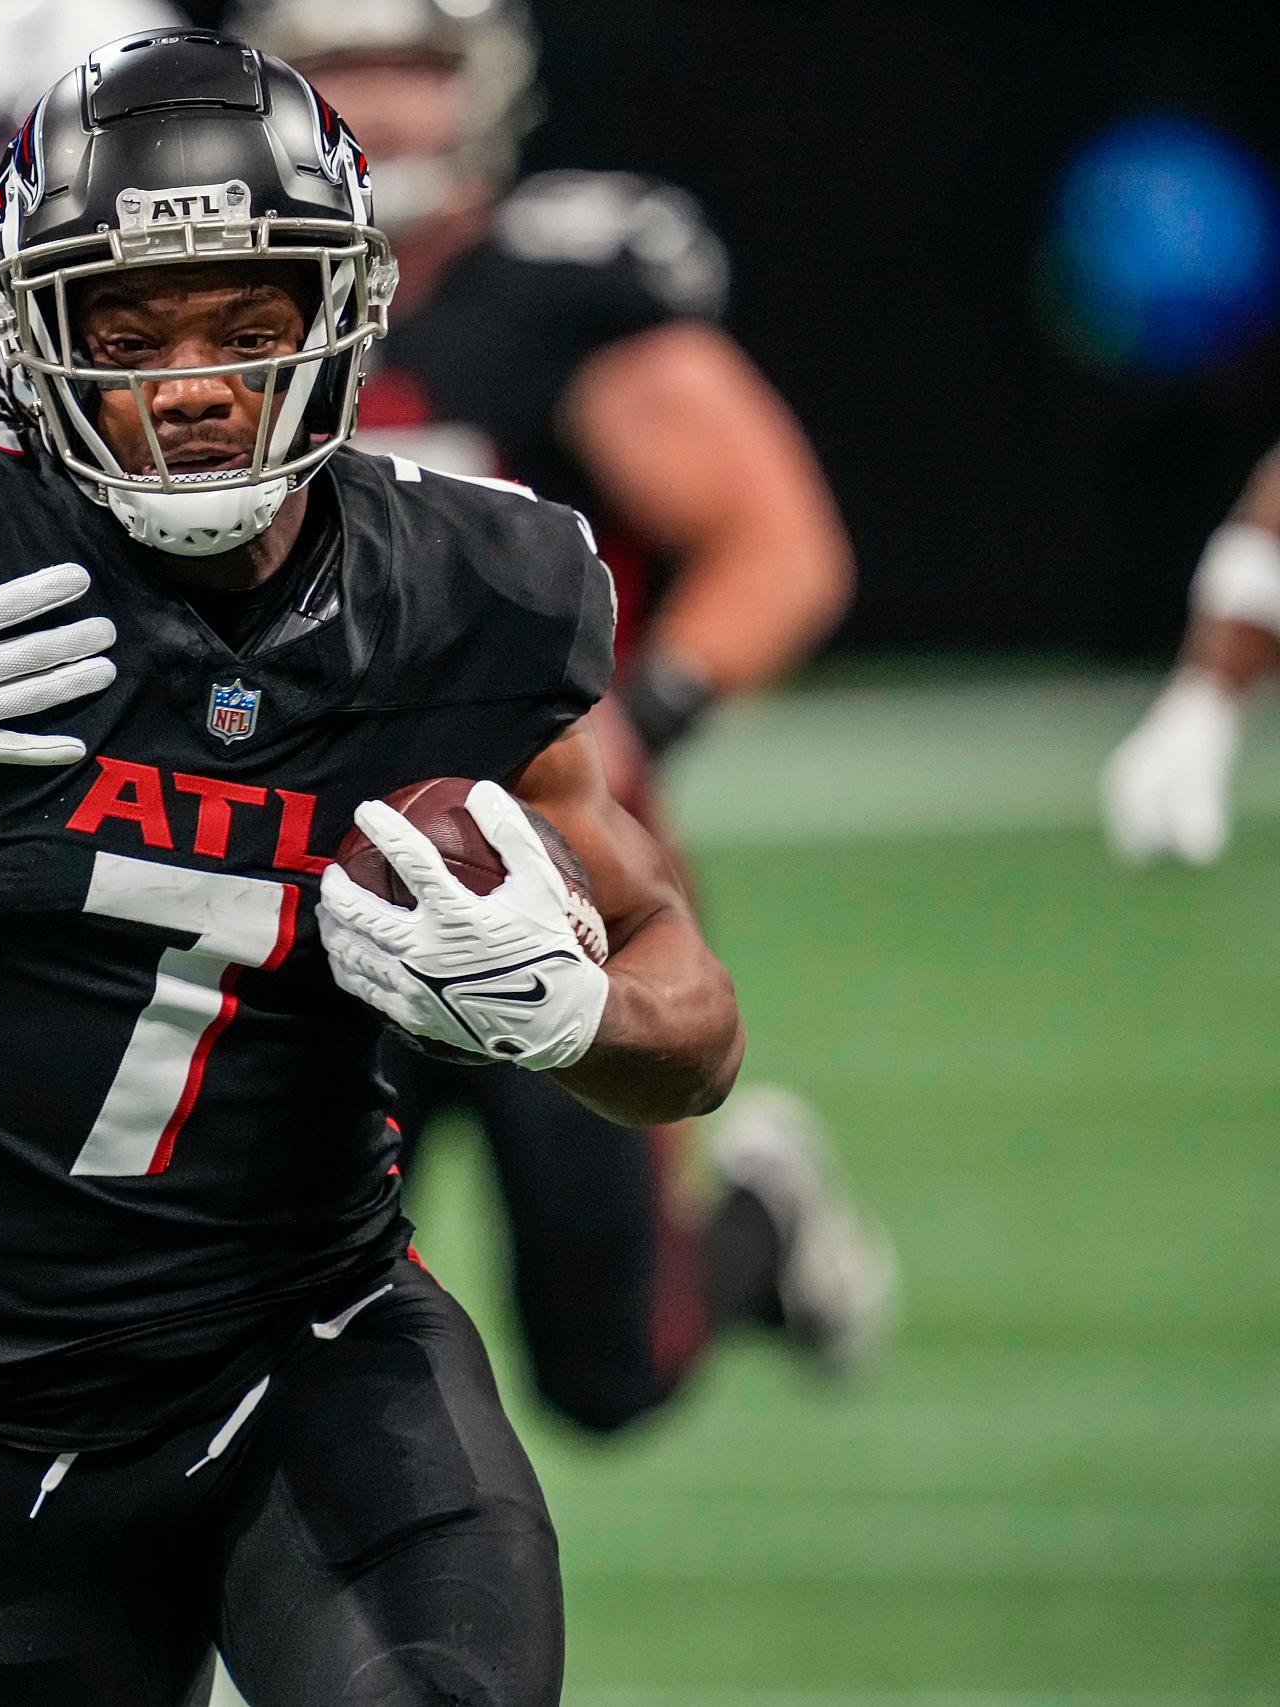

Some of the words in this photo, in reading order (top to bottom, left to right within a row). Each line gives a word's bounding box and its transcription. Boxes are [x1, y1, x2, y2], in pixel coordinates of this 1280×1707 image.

[152, 195, 220, 219] ATL
[215, 708, 248, 733] NFL
[65, 756, 334, 876] ATL
[70, 851, 300, 1176] 7
